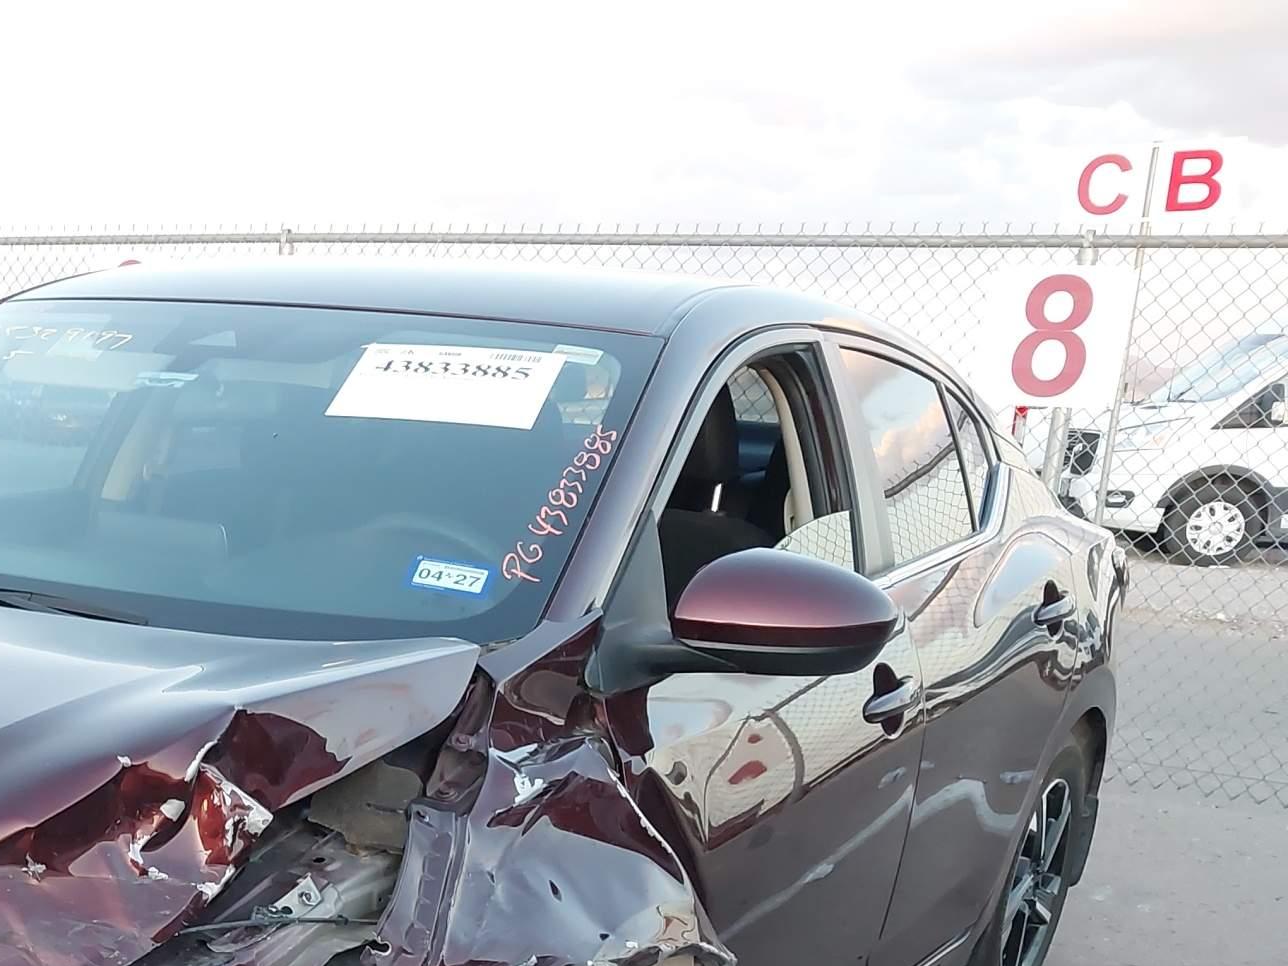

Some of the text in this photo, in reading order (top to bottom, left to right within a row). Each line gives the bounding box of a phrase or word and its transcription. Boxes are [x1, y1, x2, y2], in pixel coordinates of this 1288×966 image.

[1077, 153, 1133, 216] C
[1165, 149, 1224, 212] B
[1011, 273, 1094, 398] 8
[375, 359, 533, 381] 43833885
[528, 424, 617, 536] 43833885
[418, 567, 444, 582] 04
[453, 573, 481, 588] 27
